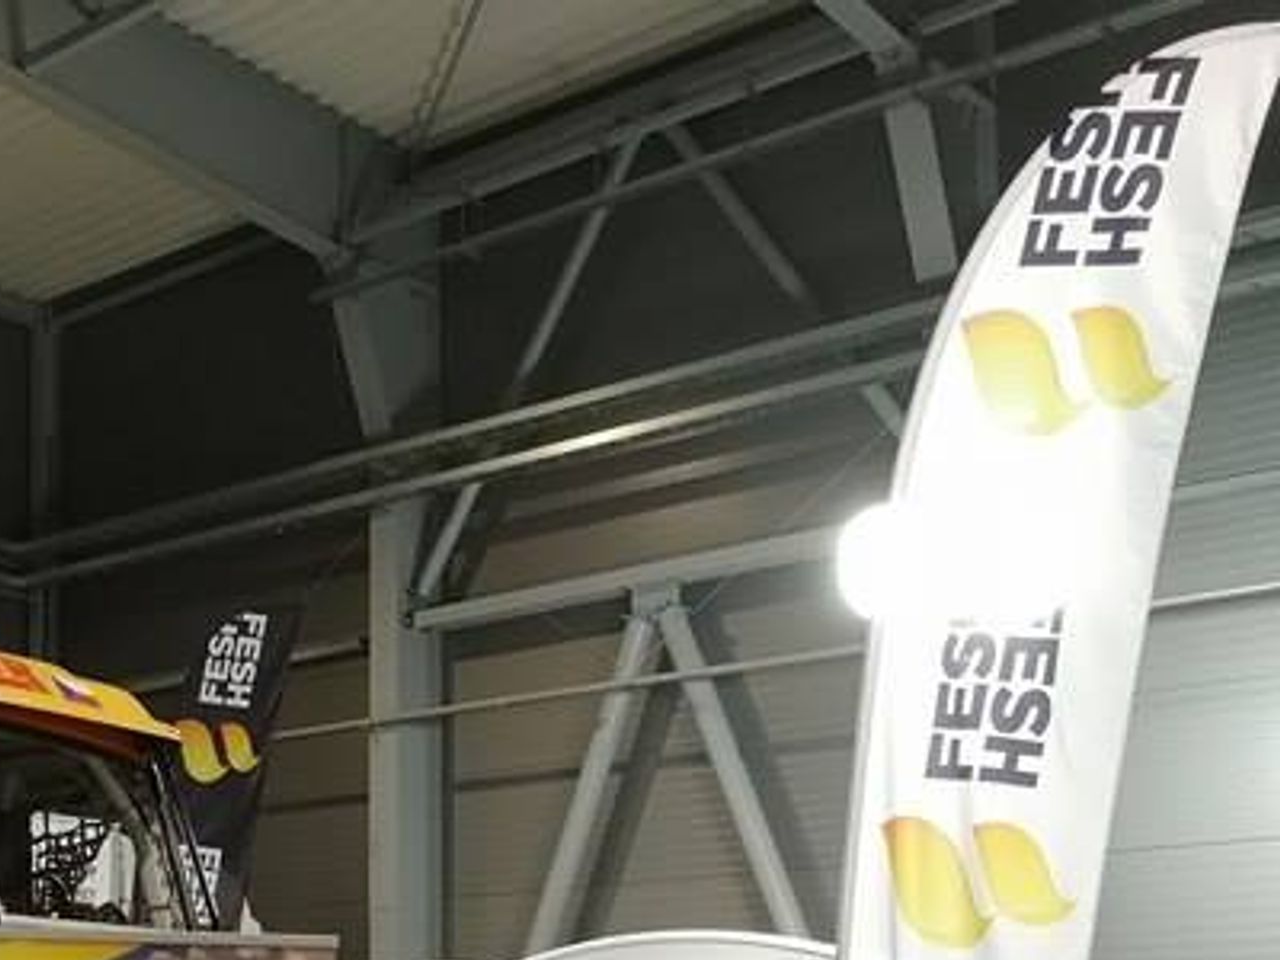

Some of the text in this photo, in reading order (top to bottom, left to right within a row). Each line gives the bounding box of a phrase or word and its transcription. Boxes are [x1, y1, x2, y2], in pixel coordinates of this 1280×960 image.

[1020, 90, 1122, 267] FES
[1083, 57, 1202, 267] FESH
[225, 614, 268, 708] FESH
[924, 619, 997, 781] FES
[978, 607, 1064, 788] ESH
